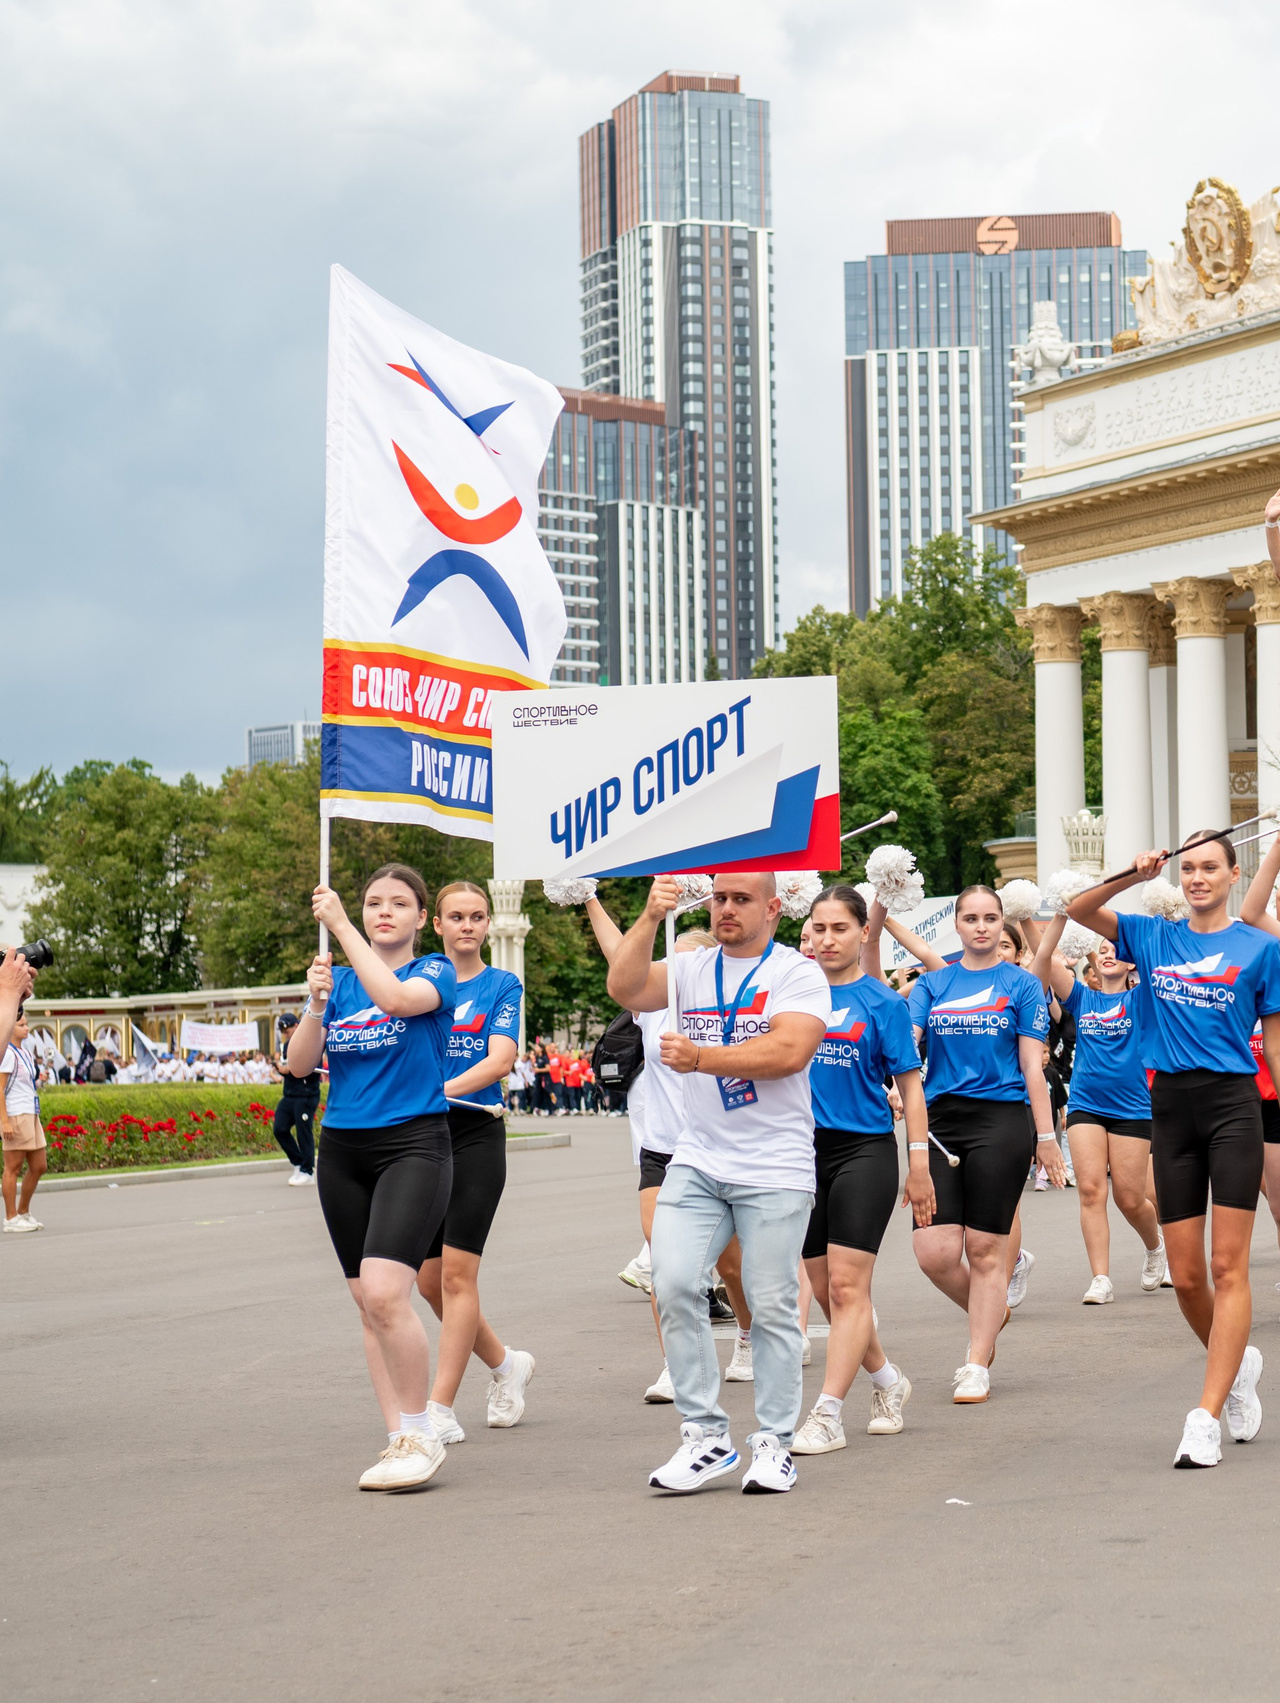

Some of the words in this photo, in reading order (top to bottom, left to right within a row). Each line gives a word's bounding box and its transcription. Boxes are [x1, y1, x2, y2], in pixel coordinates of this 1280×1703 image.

[352, 664, 413, 713] СОЮЗ
[414, 674, 462, 724] ЧИР
[512, 717, 578, 727] ШЕСТВИЕ
[410, 740, 489, 804] РОССИИ
[550, 776, 622, 860] ЧИР
[632, 695, 752, 816] СПОРТ
[893, 900, 954, 952] ААТИЧЕСКИЙ
[1155, 989, 1227, 1012] ШЕСТВИЕ
[689, 1032, 759, 1044] ШЕСТВИ
[935, 1027, 999, 1036] ШЕСТВИЕ
[1081, 1028, 1128, 1036] ШЕСТВИЕ
[328, 1036, 399, 1052] ШЕСТВИЕ
